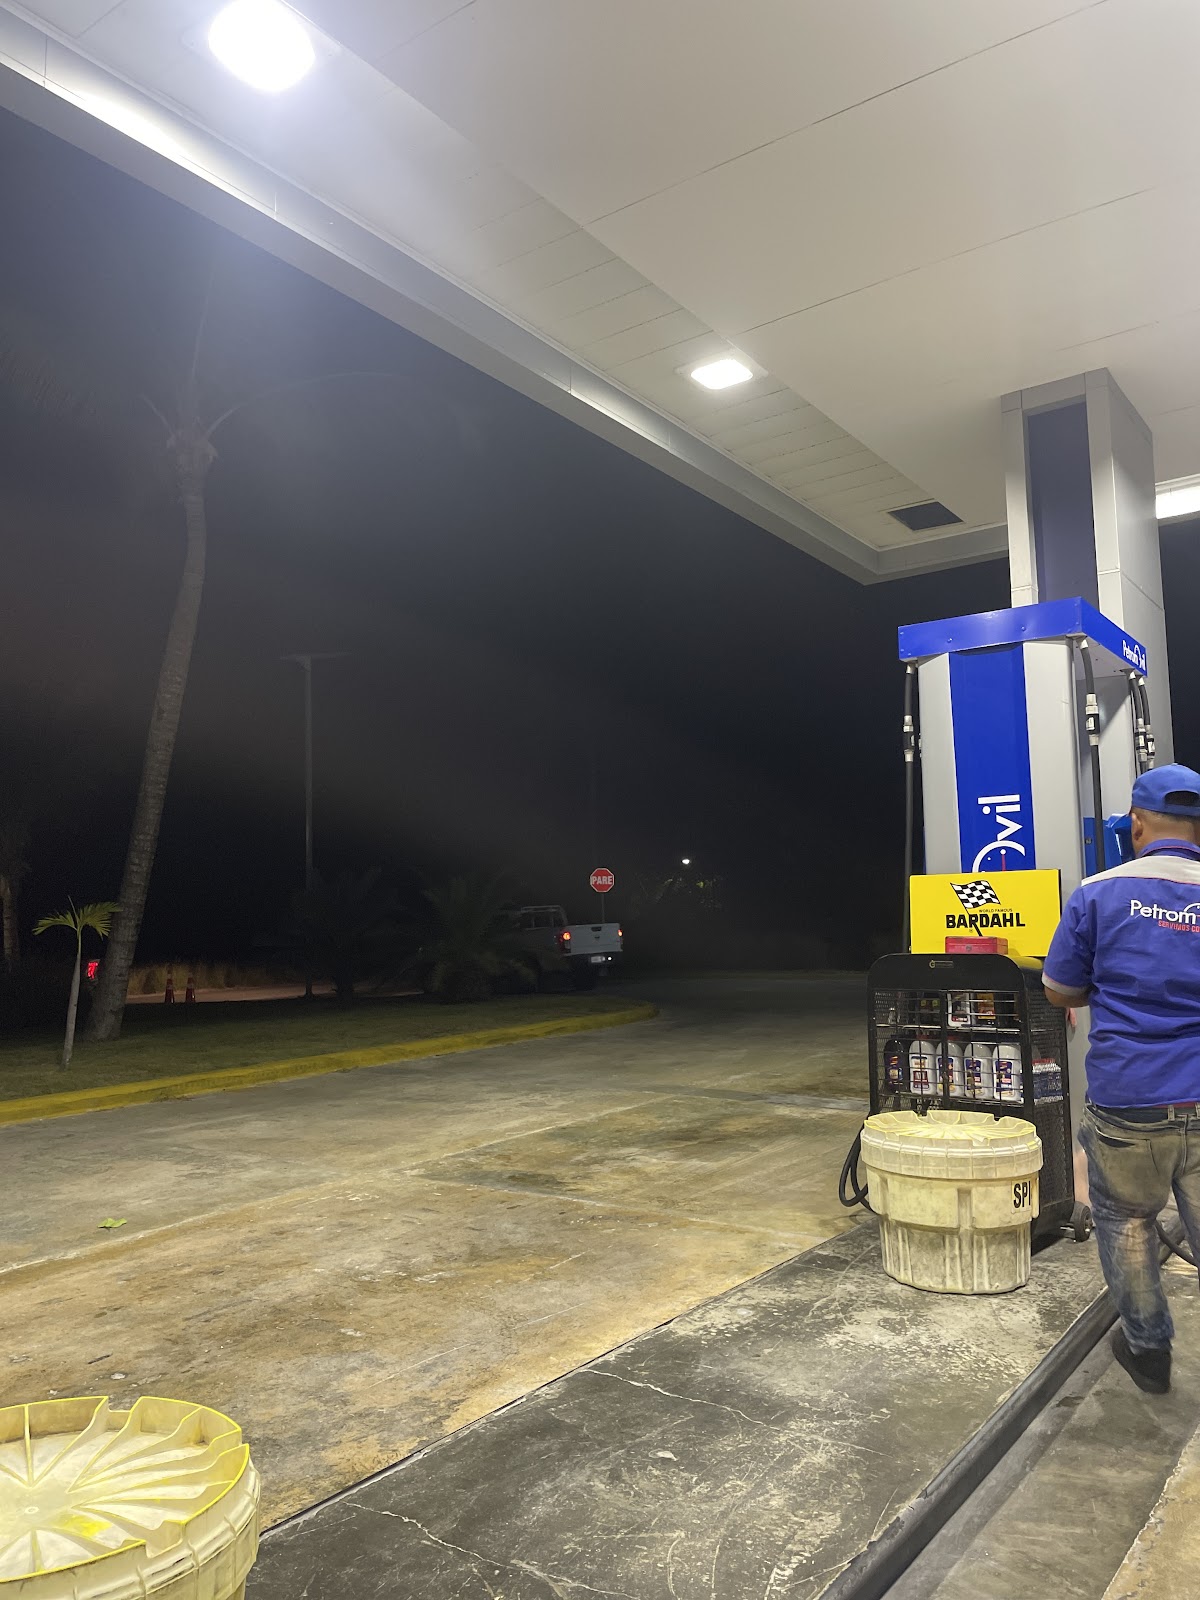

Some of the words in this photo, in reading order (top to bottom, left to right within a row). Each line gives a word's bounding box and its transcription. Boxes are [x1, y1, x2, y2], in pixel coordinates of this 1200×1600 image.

[592, 875, 613, 885] PARE
[945, 912, 1026, 929] BARDAHL
[1158, 920, 1190, 931] SERVIMOS
[1013, 1181, 1031, 1208] SPI
